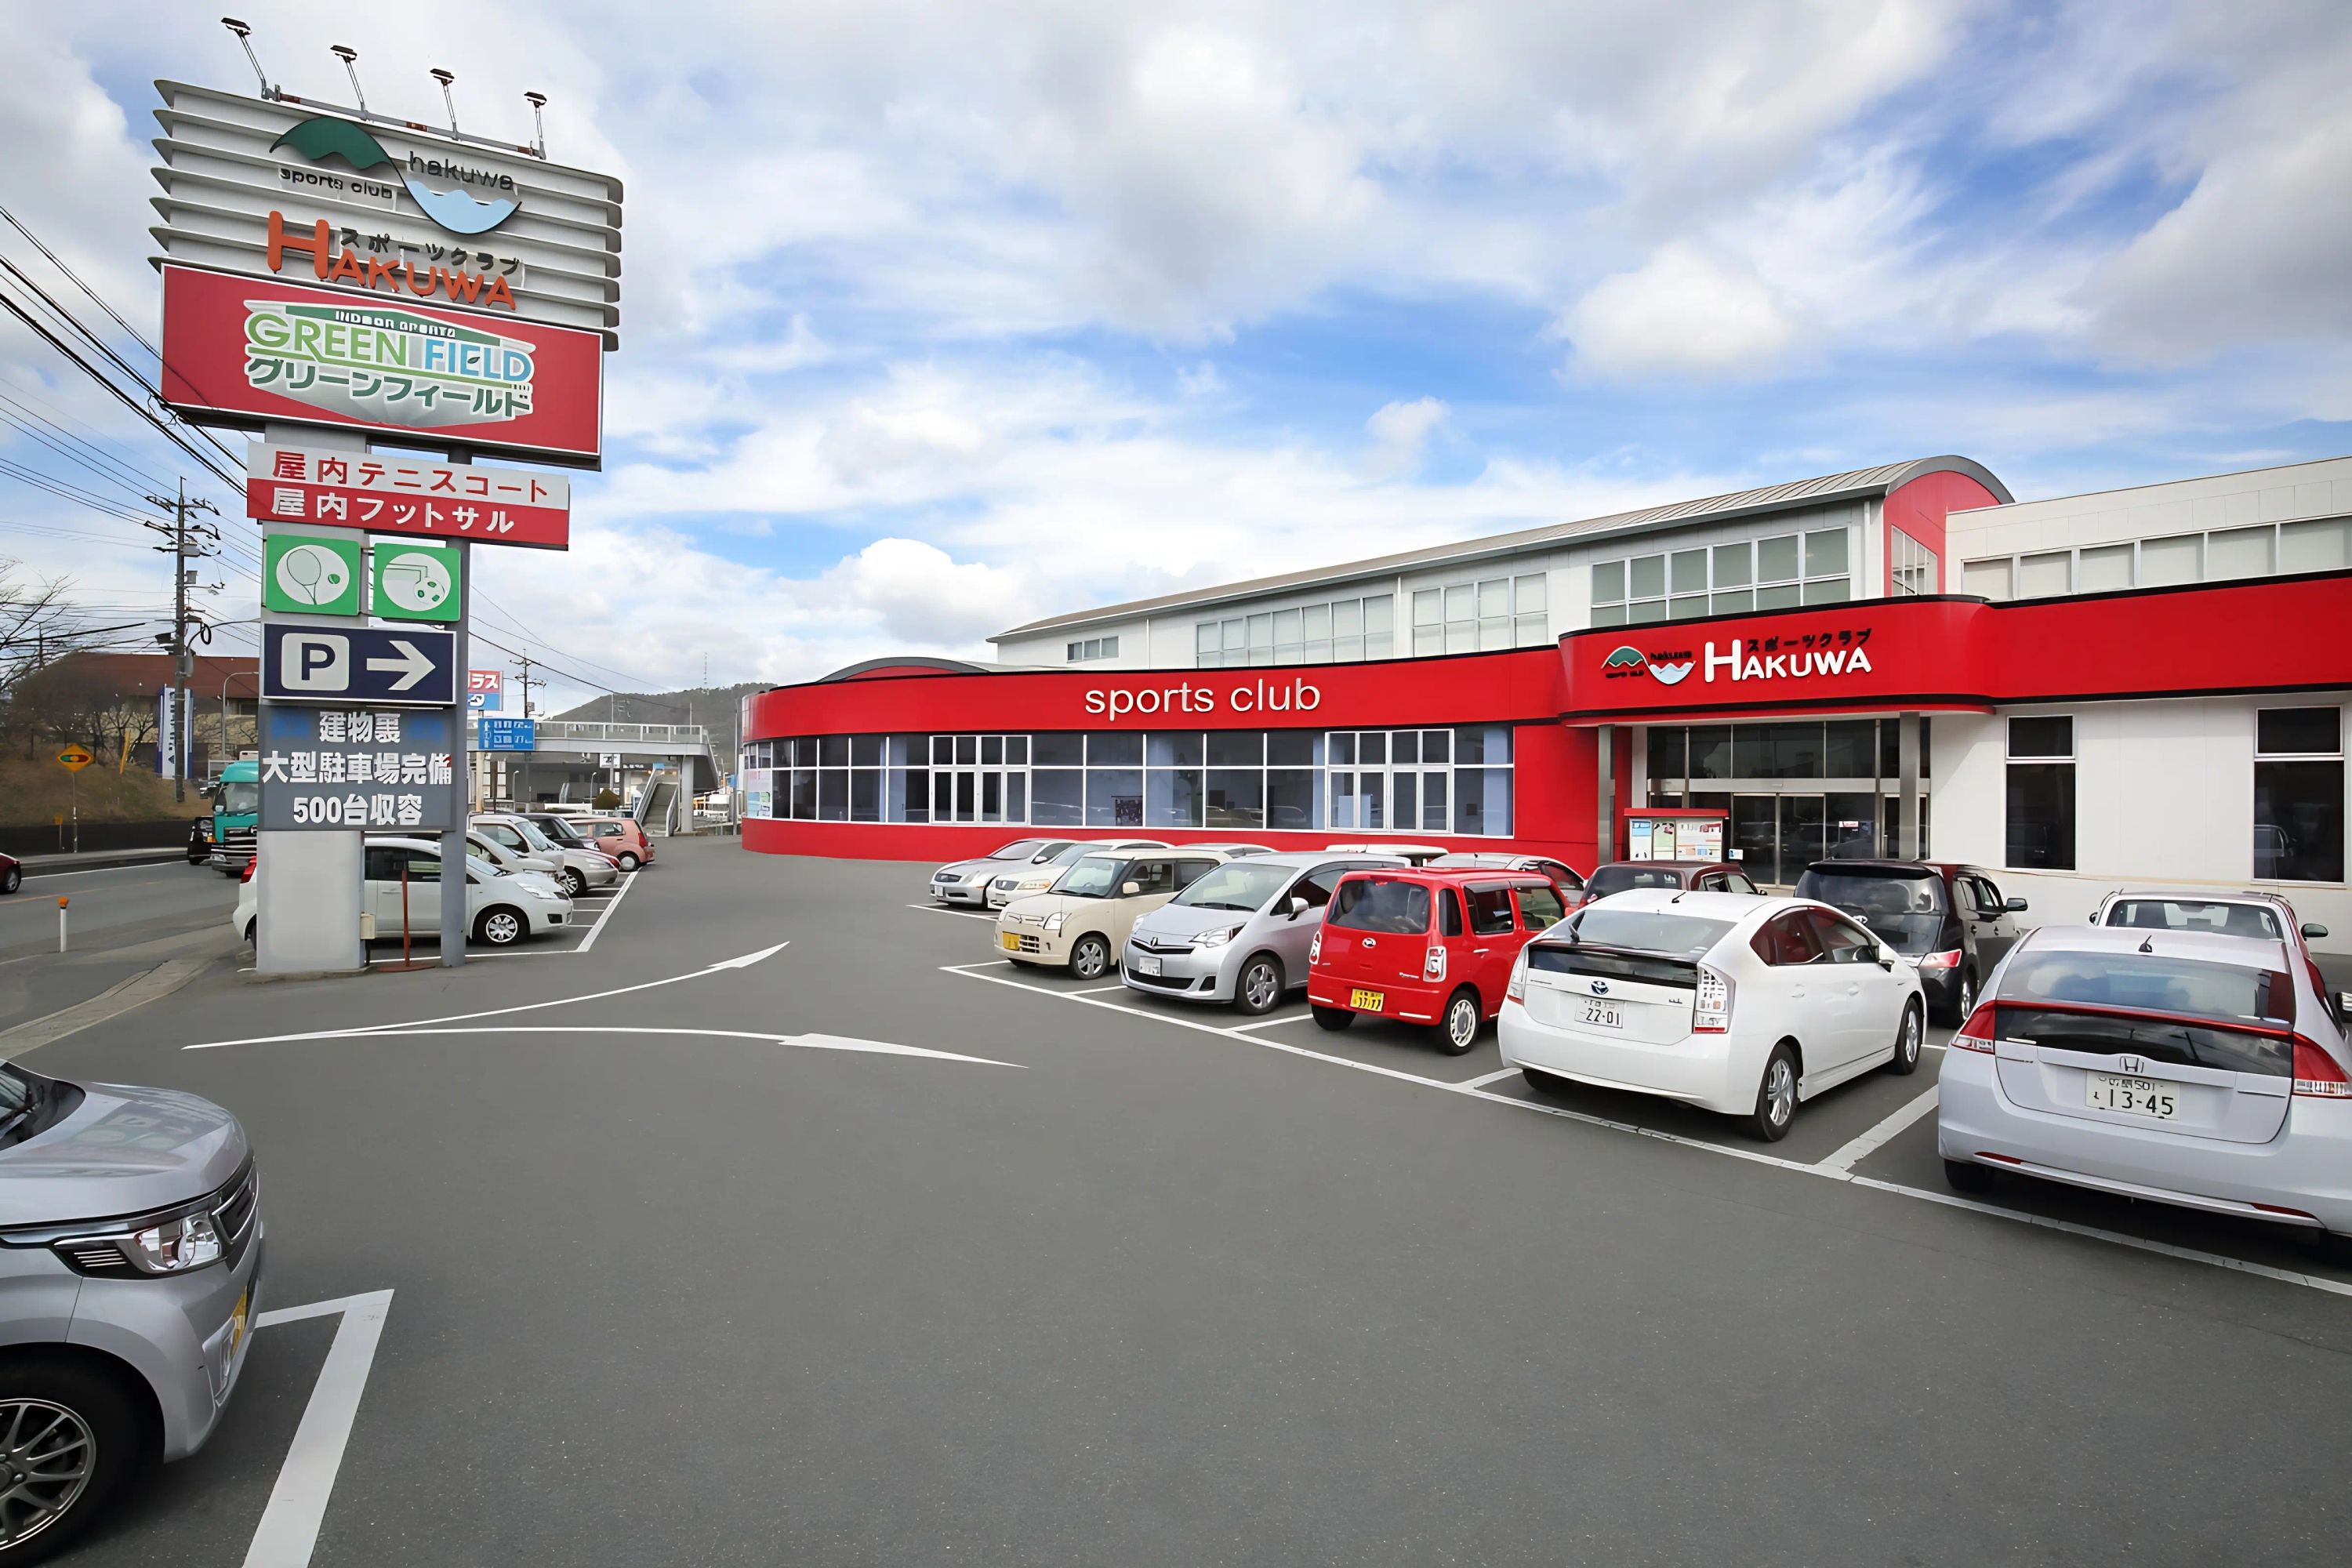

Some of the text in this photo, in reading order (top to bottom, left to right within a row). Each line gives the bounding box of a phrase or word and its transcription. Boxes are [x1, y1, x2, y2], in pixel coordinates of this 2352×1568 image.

[267, 210, 516, 310] HAKUWA
[341, 227, 519, 275] スポーツクラブ
[248, 314, 532, 382] GREEN FIELD
[248, 358, 530, 417] グリーンフィールド
[273, 451, 548, 503] 屋内テニスコート
[271, 487, 514, 533] 屋内フットサル
[301, 642, 336, 681] P
[468, 673, 499, 689] ラス
[1704, 639, 1872, 683] HAKUWA
[1085, 677, 1321, 720] sports club
[320, 711, 401, 743] 建物裏
[262, 750, 452, 785] 大型駐車場完備
[293, 793, 422, 826] 500台収容
